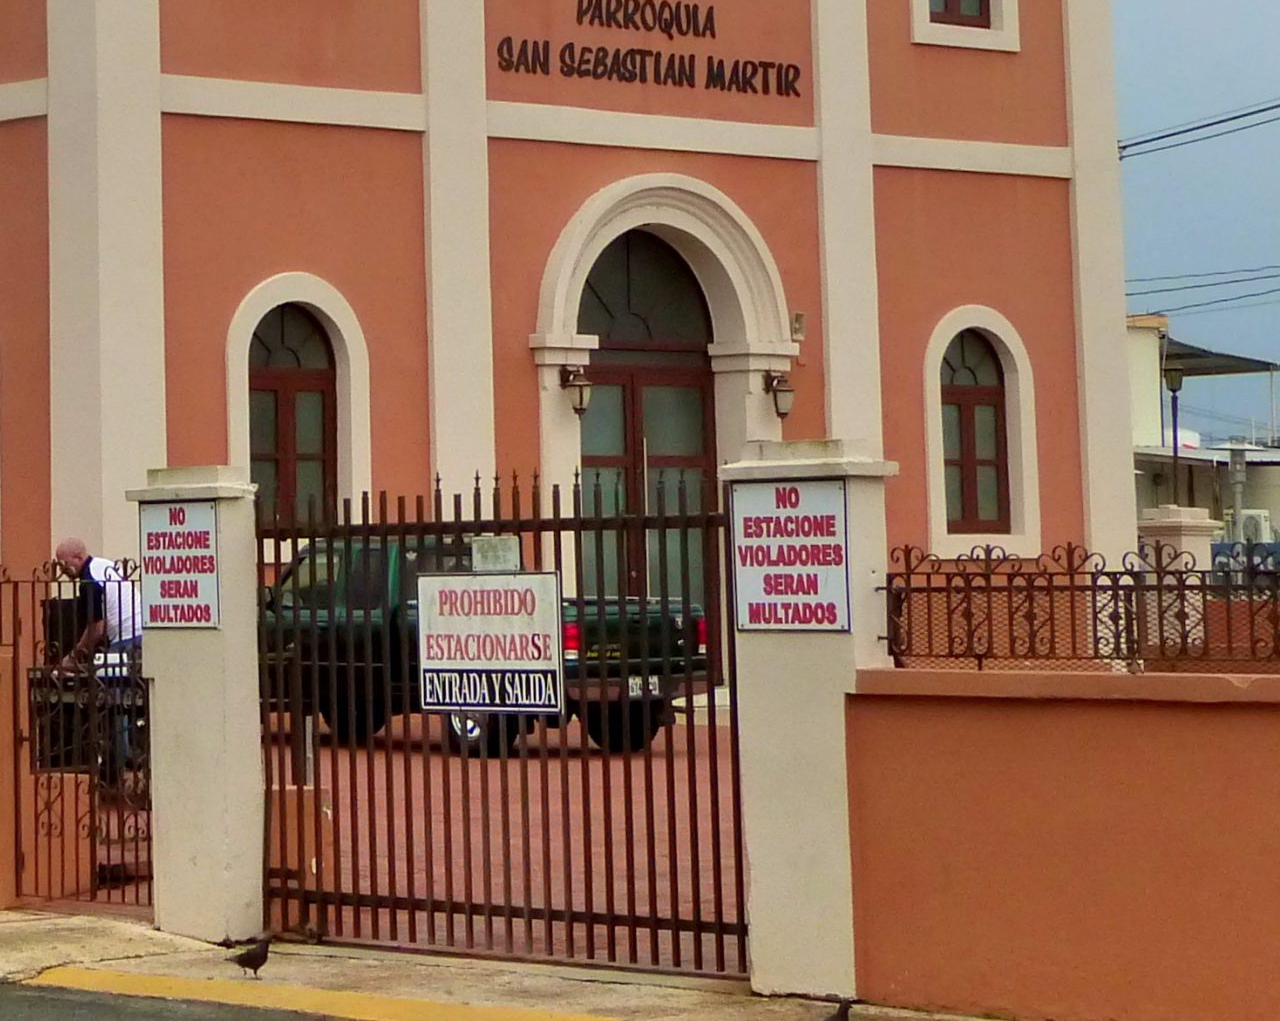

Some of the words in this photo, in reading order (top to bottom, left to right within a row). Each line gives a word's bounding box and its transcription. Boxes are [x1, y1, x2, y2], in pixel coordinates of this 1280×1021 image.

[497, 37, 550, 75] SAN
[559, 42, 696, 89] SEBASTIAN
[705, 56, 801, 97] MARTIR
[775, 486, 800, 509] NO
[169, 507, 186, 526] NO
[743, 515, 836, 538] ESTACIONE
[147, 531, 210, 550] ESTACIONE
[143, 555, 215, 574] VIOLADORES
[738, 544, 843, 567] VIOLADORES
[160, 580, 198, 599] SERAN
[763, 573, 818, 596] SERAN
[149, 604, 211, 623] MULTADOS
[438, 588, 536, 616] PROHIBIDO
[748, 602, 837, 625] MULTADOS
[425, 633, 552, 661] ESTACIONARSE
[425, 672, 490, 704] ENTRADA
[491, 673, 504, 704] Y
[504, 672, 556, 705] SALIDA
